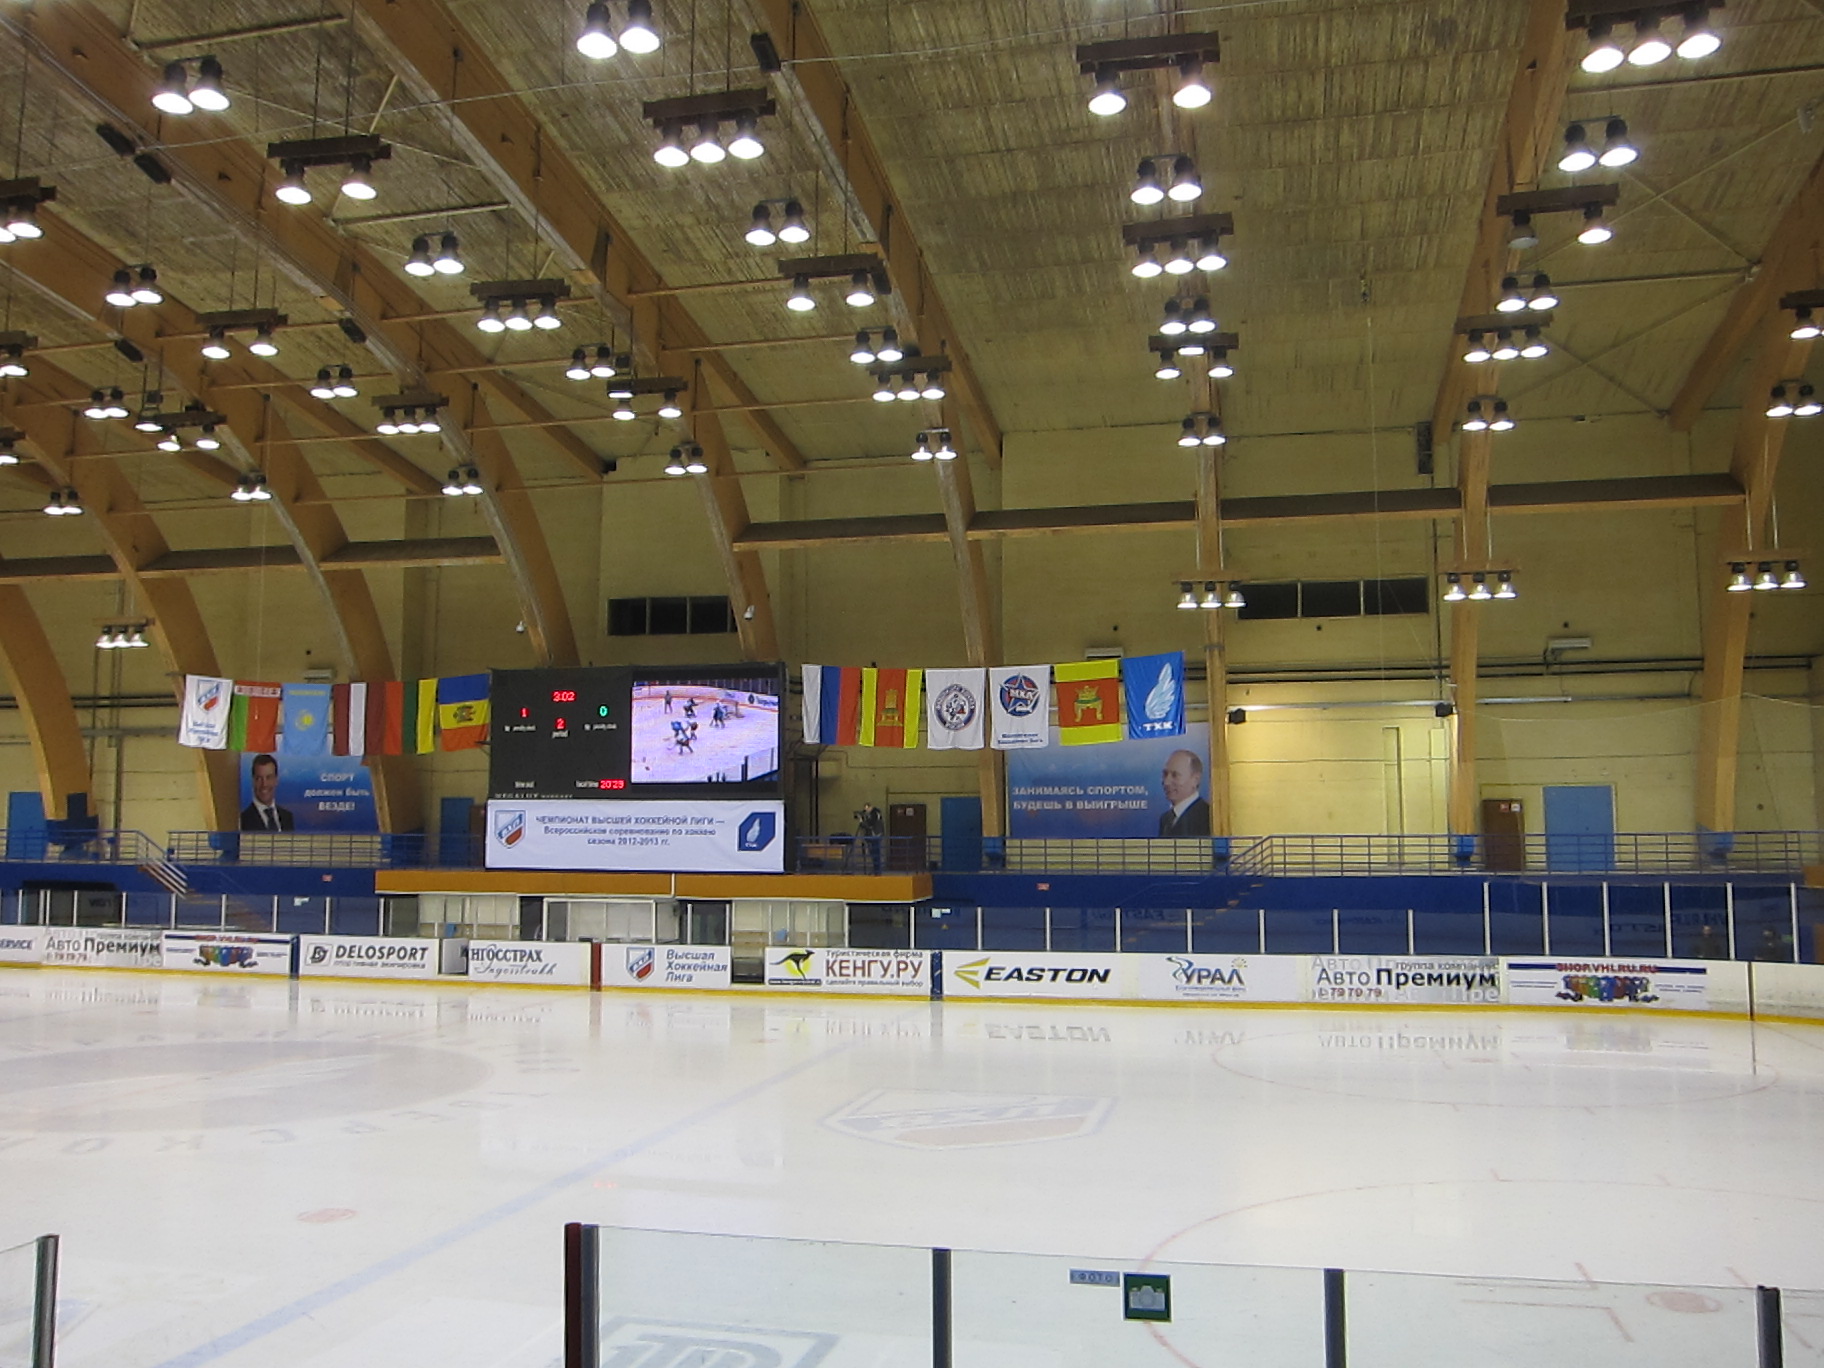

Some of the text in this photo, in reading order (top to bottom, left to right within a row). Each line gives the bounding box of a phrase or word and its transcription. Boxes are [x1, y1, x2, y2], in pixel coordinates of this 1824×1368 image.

[599, 705, 608, 717] 0
[556, 718, 565, 729] 2
[1142, 721, 1174, 732] ТХК
[1012, 786, 1084, 795] ЗАНИМАЯСЬ
[1013, 800, 1148, 811] БУДЕШЬ В ВЫИГРЫШЕ
[536, 816, 589, 824] ЧЕМПИОНАТ
[591, 815, 632, 824] ВЫСШЕЙ
[634, 815, 688, 824] ХОККЕЙНОЙ
[46, 937, 80, 951] Авто
[84, 937, 160, 957] Премиум
[335, 945, 428, 960] DELOSPORT
[666, 949, 715, 960] Высшая
[665, 961, 728, 971] Хоккейная
[825, 959, 923, 979] КЕНГУ.РУ
[666, 971, 693, 982] Лига
[985, 967, 1111, 983] EASTON
[1181, 967, 1245, 985] УРАЛ
[1317, 968, 1497, 990] Авто Премиум
